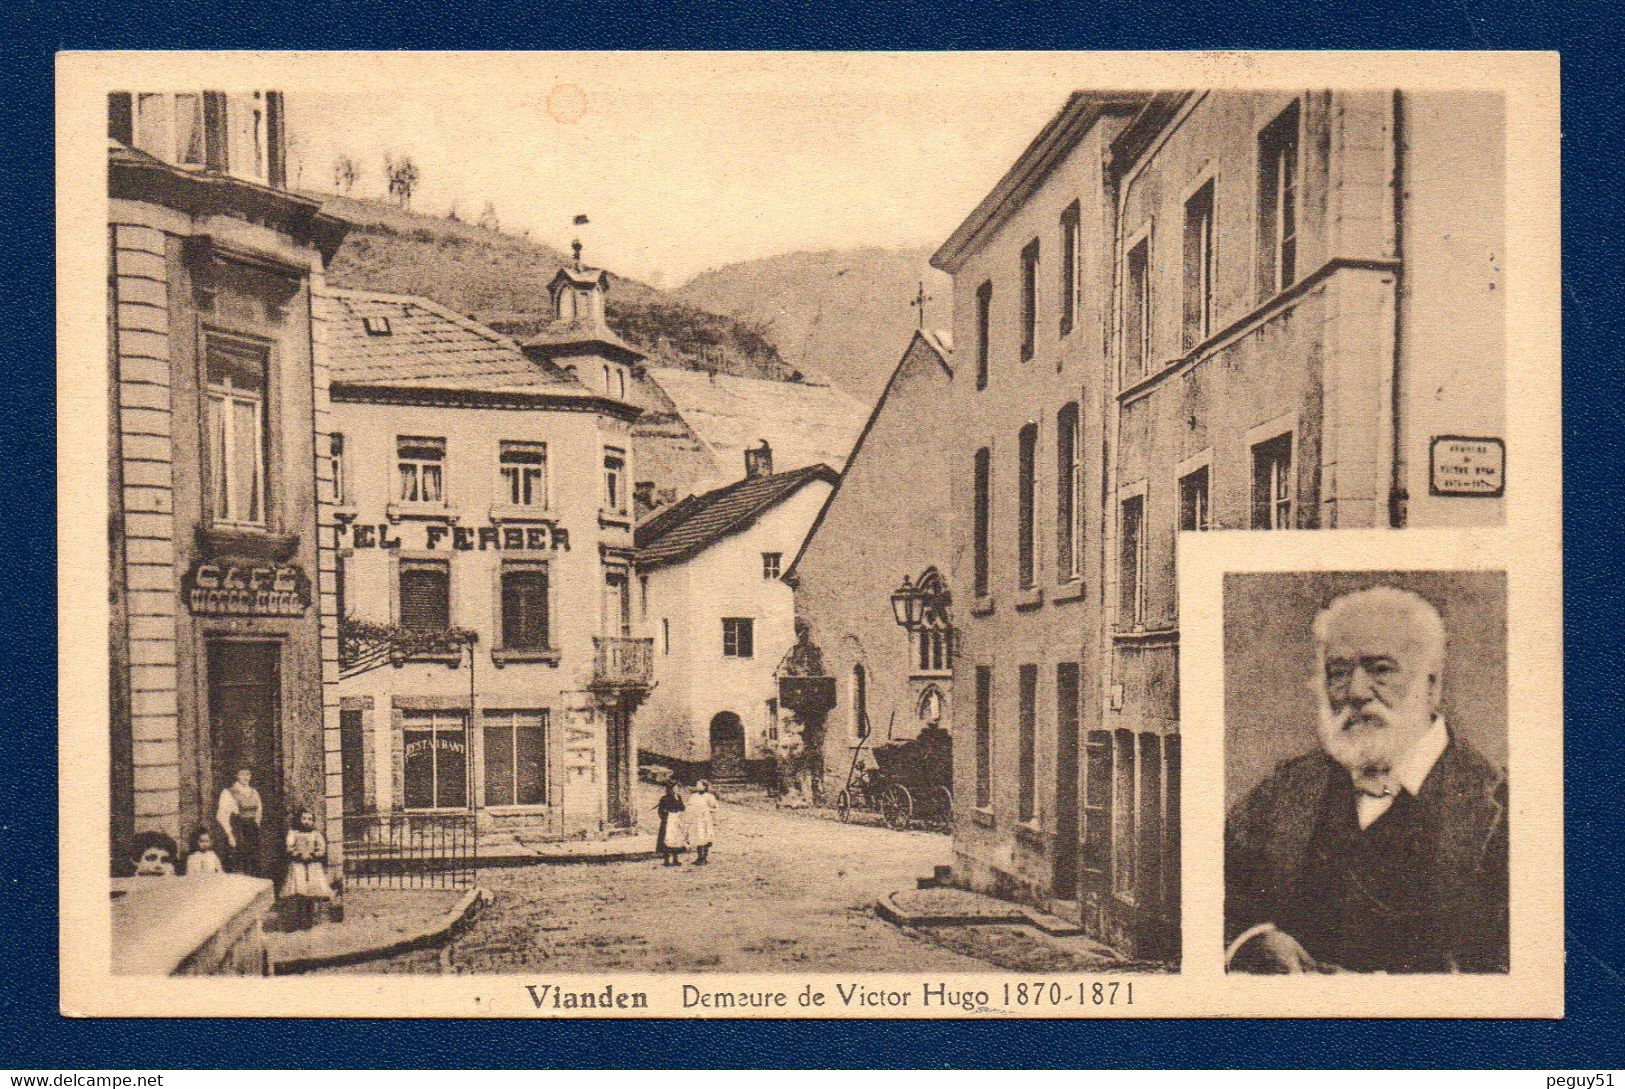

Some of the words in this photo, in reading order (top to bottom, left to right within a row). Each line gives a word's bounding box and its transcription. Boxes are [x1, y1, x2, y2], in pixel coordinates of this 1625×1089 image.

[426, 525, 571, 551] FERBER
[525, 984, 649, 1009] Vianden
[798, 984, 825, 1007] de
[837, 983, 911, 1007] Victor
[923, 983, 989, 1010] Hugo
[1003, 982, 1134, 1006] 1870-1871
